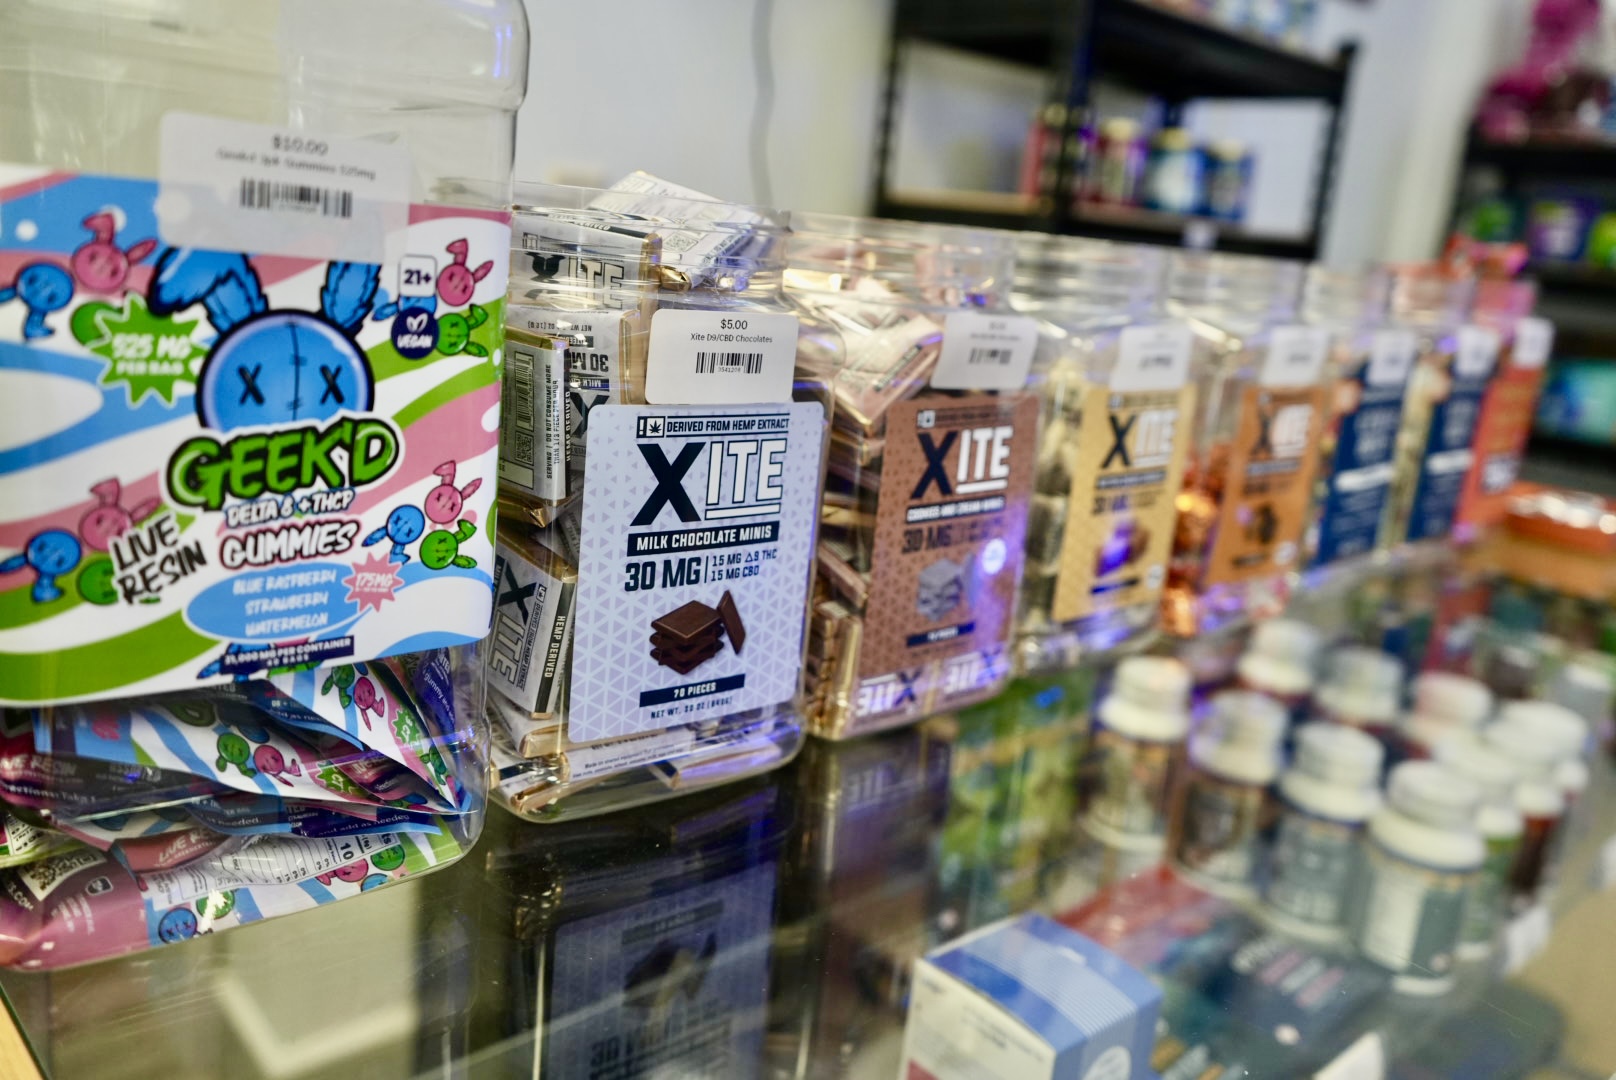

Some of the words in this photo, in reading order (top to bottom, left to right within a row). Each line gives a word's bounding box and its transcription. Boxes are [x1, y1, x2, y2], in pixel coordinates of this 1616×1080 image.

[403, 267, 433, 285] 21+
[720, 318, 748, 330] $5.00
[396, 334, 433, 349] VEGAN
[690, 333, 705, 341] Xite
[706, 333, 734, 342] D9/CBD
[735, 334, 773, 344] Chocolates
[590, 353, 609, 373] 30
[666, 421, 703, 432] DERIVED
[706, 420, 730, 431] FROM
[732, 419, 756, 431] HEMP
[757, 418, 790, 430] EXTRACT
[166, 416, 399, 512] GEEK'D
[910, 425, 1013, 499] XITE
[630, 438, 788, 527] XITE
[227, 498, 278, 528] DELTA
[113, 514, 178, 571] LIVE
[221, 520, 359, 570] GUMMIES
[636, 535, 669, 551] MILK
[671, 529, 737, 548] CHOCOLATE
[739, 525, 772, 542] MINIS
[713, 555, 725, 567] 15
[726, 552, 742, 565] MG
[762, 549, 778, 560] THC
[117, 539, 208, 605] RESIN
[624, 560, 657, 592] 30
[661, 557, 702, 588] MG
[711, 570, 723, 582] 15
[725, 568, 741, 580] MG
[742, 564, 760, 578] CBD
[244, 612, 329, 637] WATERMELON
[554, 615, 567, 640] HEMP
[298, 637, 351, 654] CONTAINER
[544, 642, 560, 678] DERIVED
[687, 682, 717, 696] PIECES
[650, 709, 665, 719] NET
